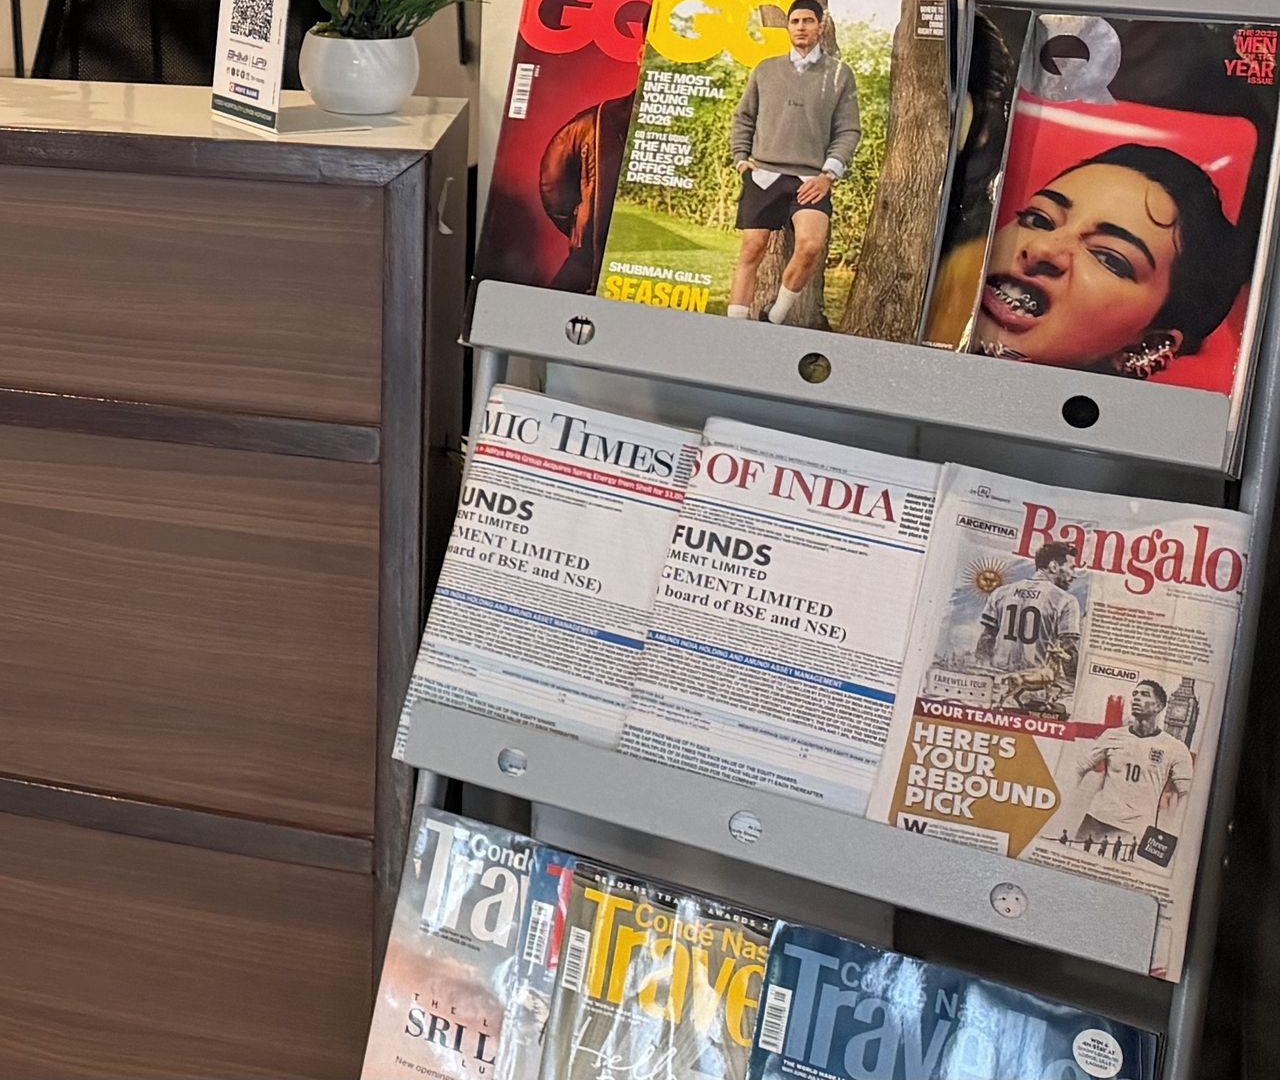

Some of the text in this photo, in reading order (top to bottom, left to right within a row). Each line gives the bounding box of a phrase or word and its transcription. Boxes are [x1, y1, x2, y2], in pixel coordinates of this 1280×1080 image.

[1237, 36, 1278, 53] MEN
[646, 70, 713, 86] THE MOST
[1224, 59, 1275, 77] YEAR
[642, 92, 689, 106] YOUNG
[643, 81, 727, 99] INFLUENTIAL
[637, 113, 672, 126] 2026
[639, 102, 695, 118] INDIANS
[630, 150, 693, 167] RULES OF
[633, 139, 692, 156] THE NEW
[626, 172, 694, 190] DRESSING
[628, 161, 676, 176] OFFICE
[608, 261, 713, 285] SHUBMAN GILL'S
[604, 275, 710, 313] SEASON
[706, 452, 766, 490] OF
[768, 465, 897, 523] INDIA
[460, 486, 535, 522] UNDS
[478, 513, 530, 536] LIMITED
[959, 516, 1016, 537] ARGENTINA
[509, 538, 590, 572] LIMITED
[671, 524, 772, 567] FUNDS
[479, 549, 495, 564] of
[497, 555, 529, 576] BSE
[532, 563, 559, 583] and
[563, 572, 603, 595] NSE)
[711, 560, 768, 582] LIMITED
[661, 565, 744, 597] GEMENT
[747, 585, 833, 619] LIMITED
[1014, 587, 1040, 600] MESSI
[664, 584, 847, 643] board of BSE and NSE)
[1003, 604, 1041, 645] 10
[698, 645, 727, 657] HOLDING
[727, 653, 743, 662] AND
[744, 657, 769, 668] AMUNDI
[770, 664, 793, 675] ASSET
[793, 670, 842, 687] MANAGEMENT
[1092, 664, 1137, 680] ENGLAND
[920, 701, 1066, 736] YOUR TEAM'S OUT?
[913, 724, 1016, 760] HERE'S
[910, 746, 996, 780] YOUR
[1125, 762, 1141, 783] 10
[903, 786, 975, 820] PICK
[907, 765, 1057, 812] REBOUND
[420, 817, 529, 950] Tra
[657, 892, 702, 912] TRAVL
[707, 908, 756, 928] AWARDS
[635, 904, 714, 947] Condé
[404, 1007, 468, 1054] SRI
[395, 1055, 415, 1068] New
